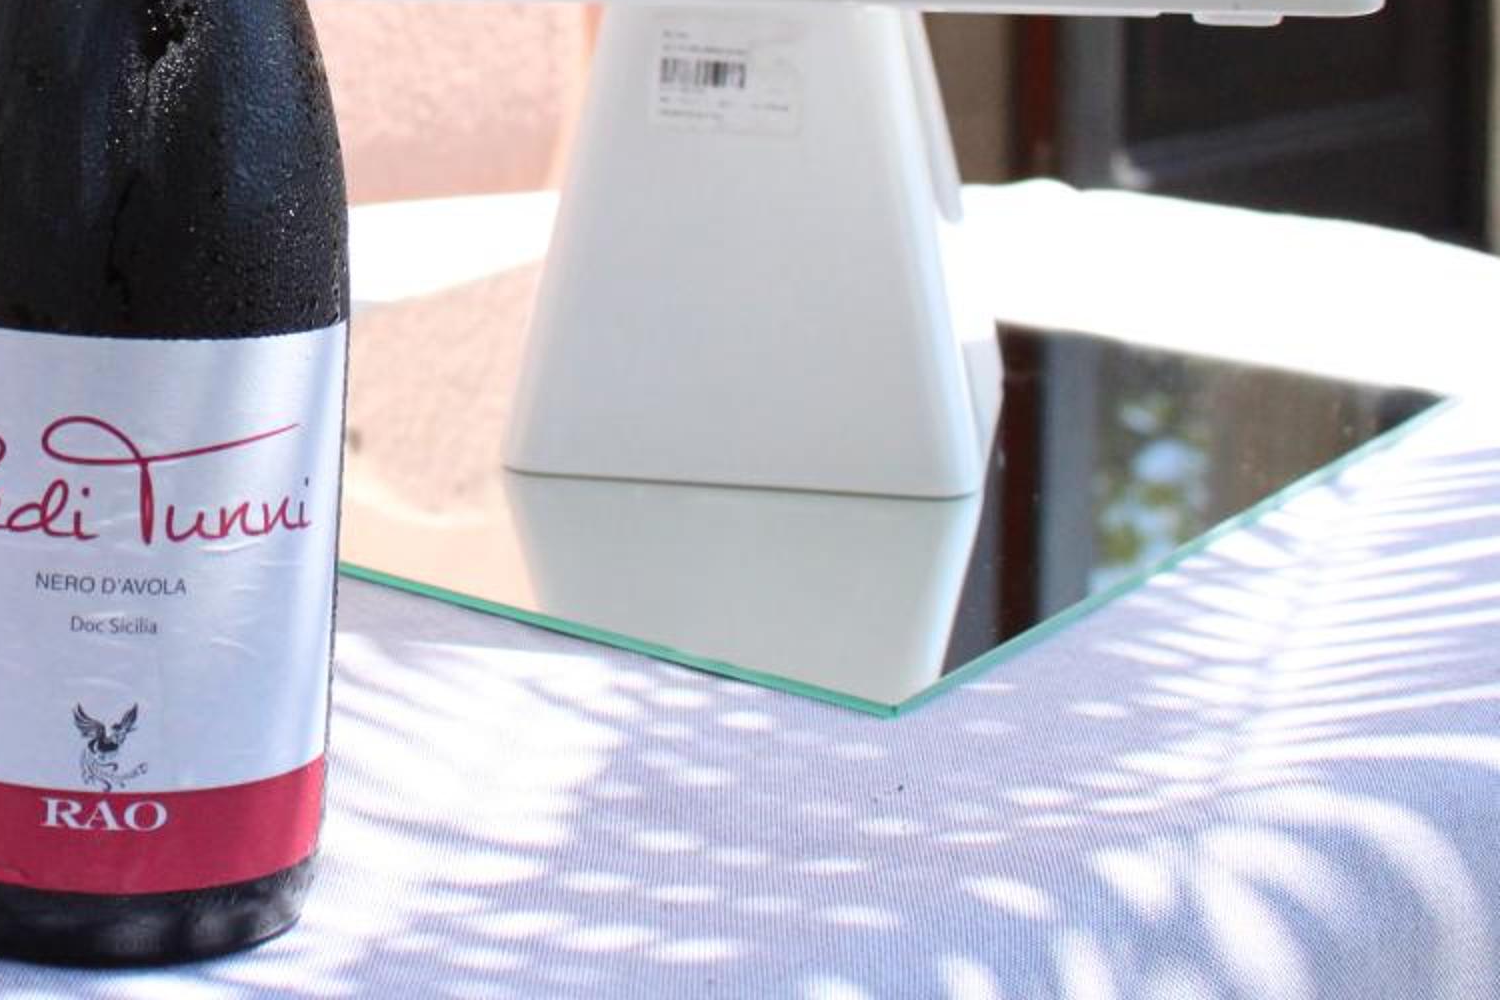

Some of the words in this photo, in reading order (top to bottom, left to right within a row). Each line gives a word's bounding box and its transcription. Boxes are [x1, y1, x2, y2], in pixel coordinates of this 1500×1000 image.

[35, 571, 96, 594] NERO
[102, 575, 188, 597] D'AVOLA
[70, 615, 105, 635] Doc
[109, 617, 158, 636] Sicilia
[40, 797, 169, 832] RAO
